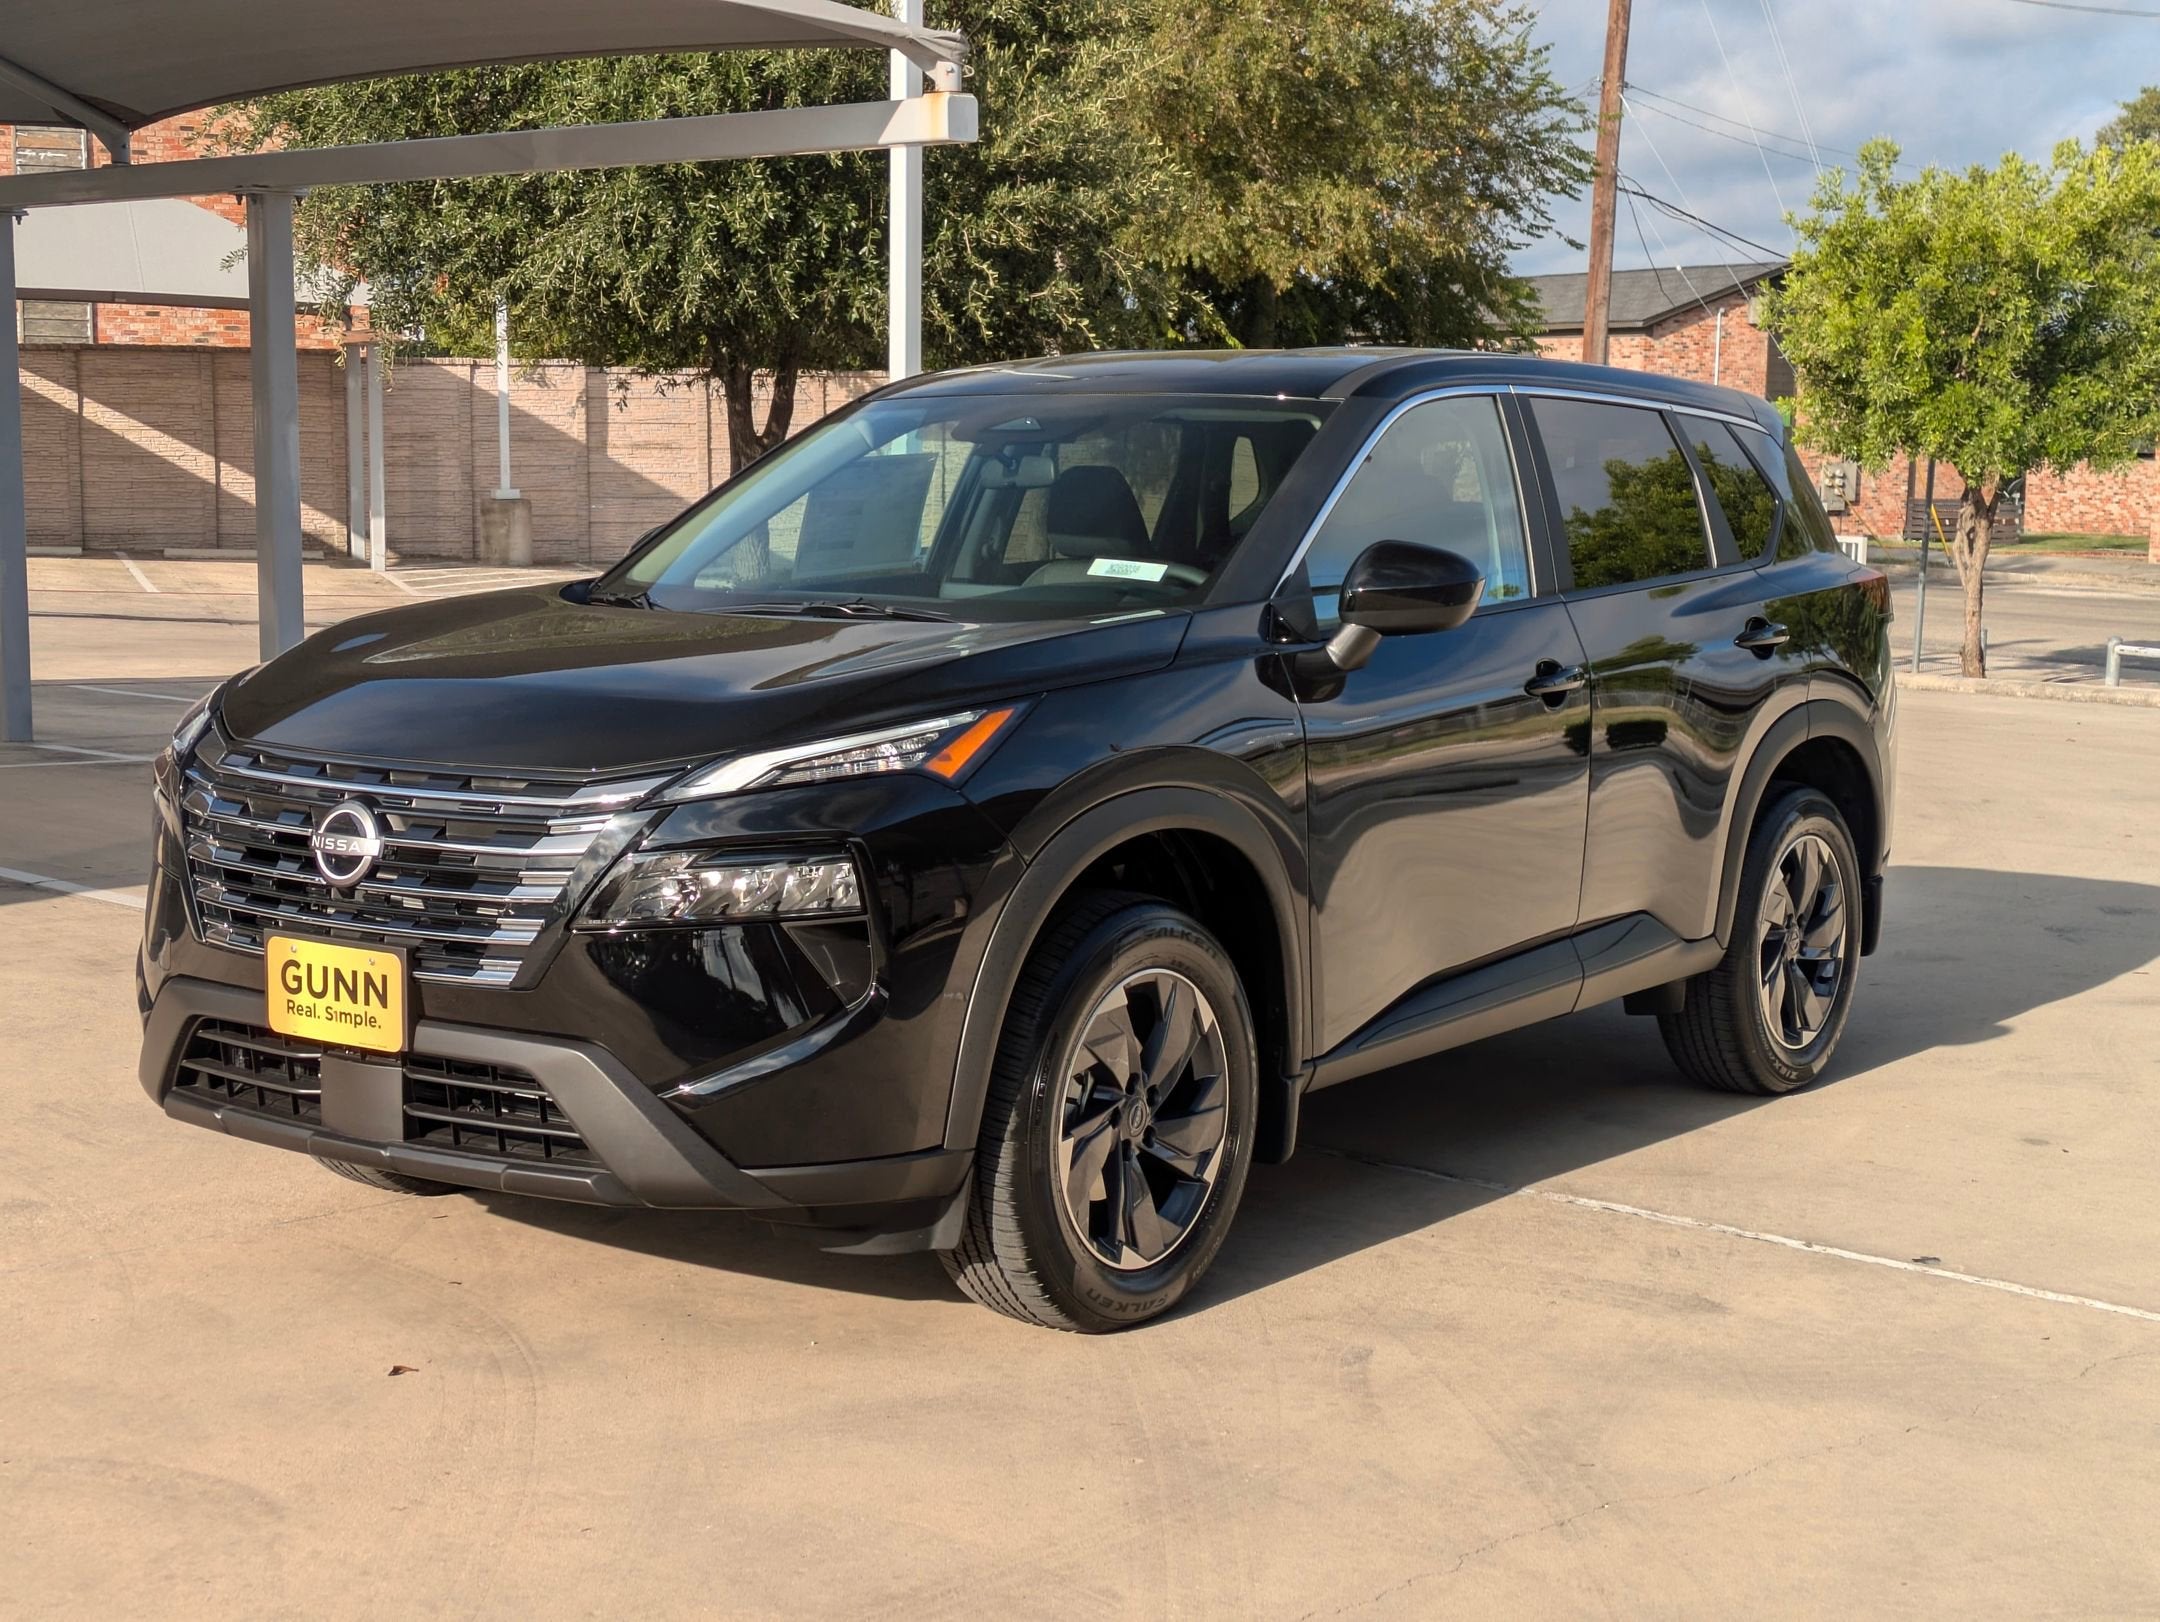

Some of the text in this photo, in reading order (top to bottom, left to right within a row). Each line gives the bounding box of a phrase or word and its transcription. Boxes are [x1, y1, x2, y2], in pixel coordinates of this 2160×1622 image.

[312, 834, 377, 855] NISSA
[281, 958, 388, 1010] GUNN
[286, 998, 321, 1020] Real.
